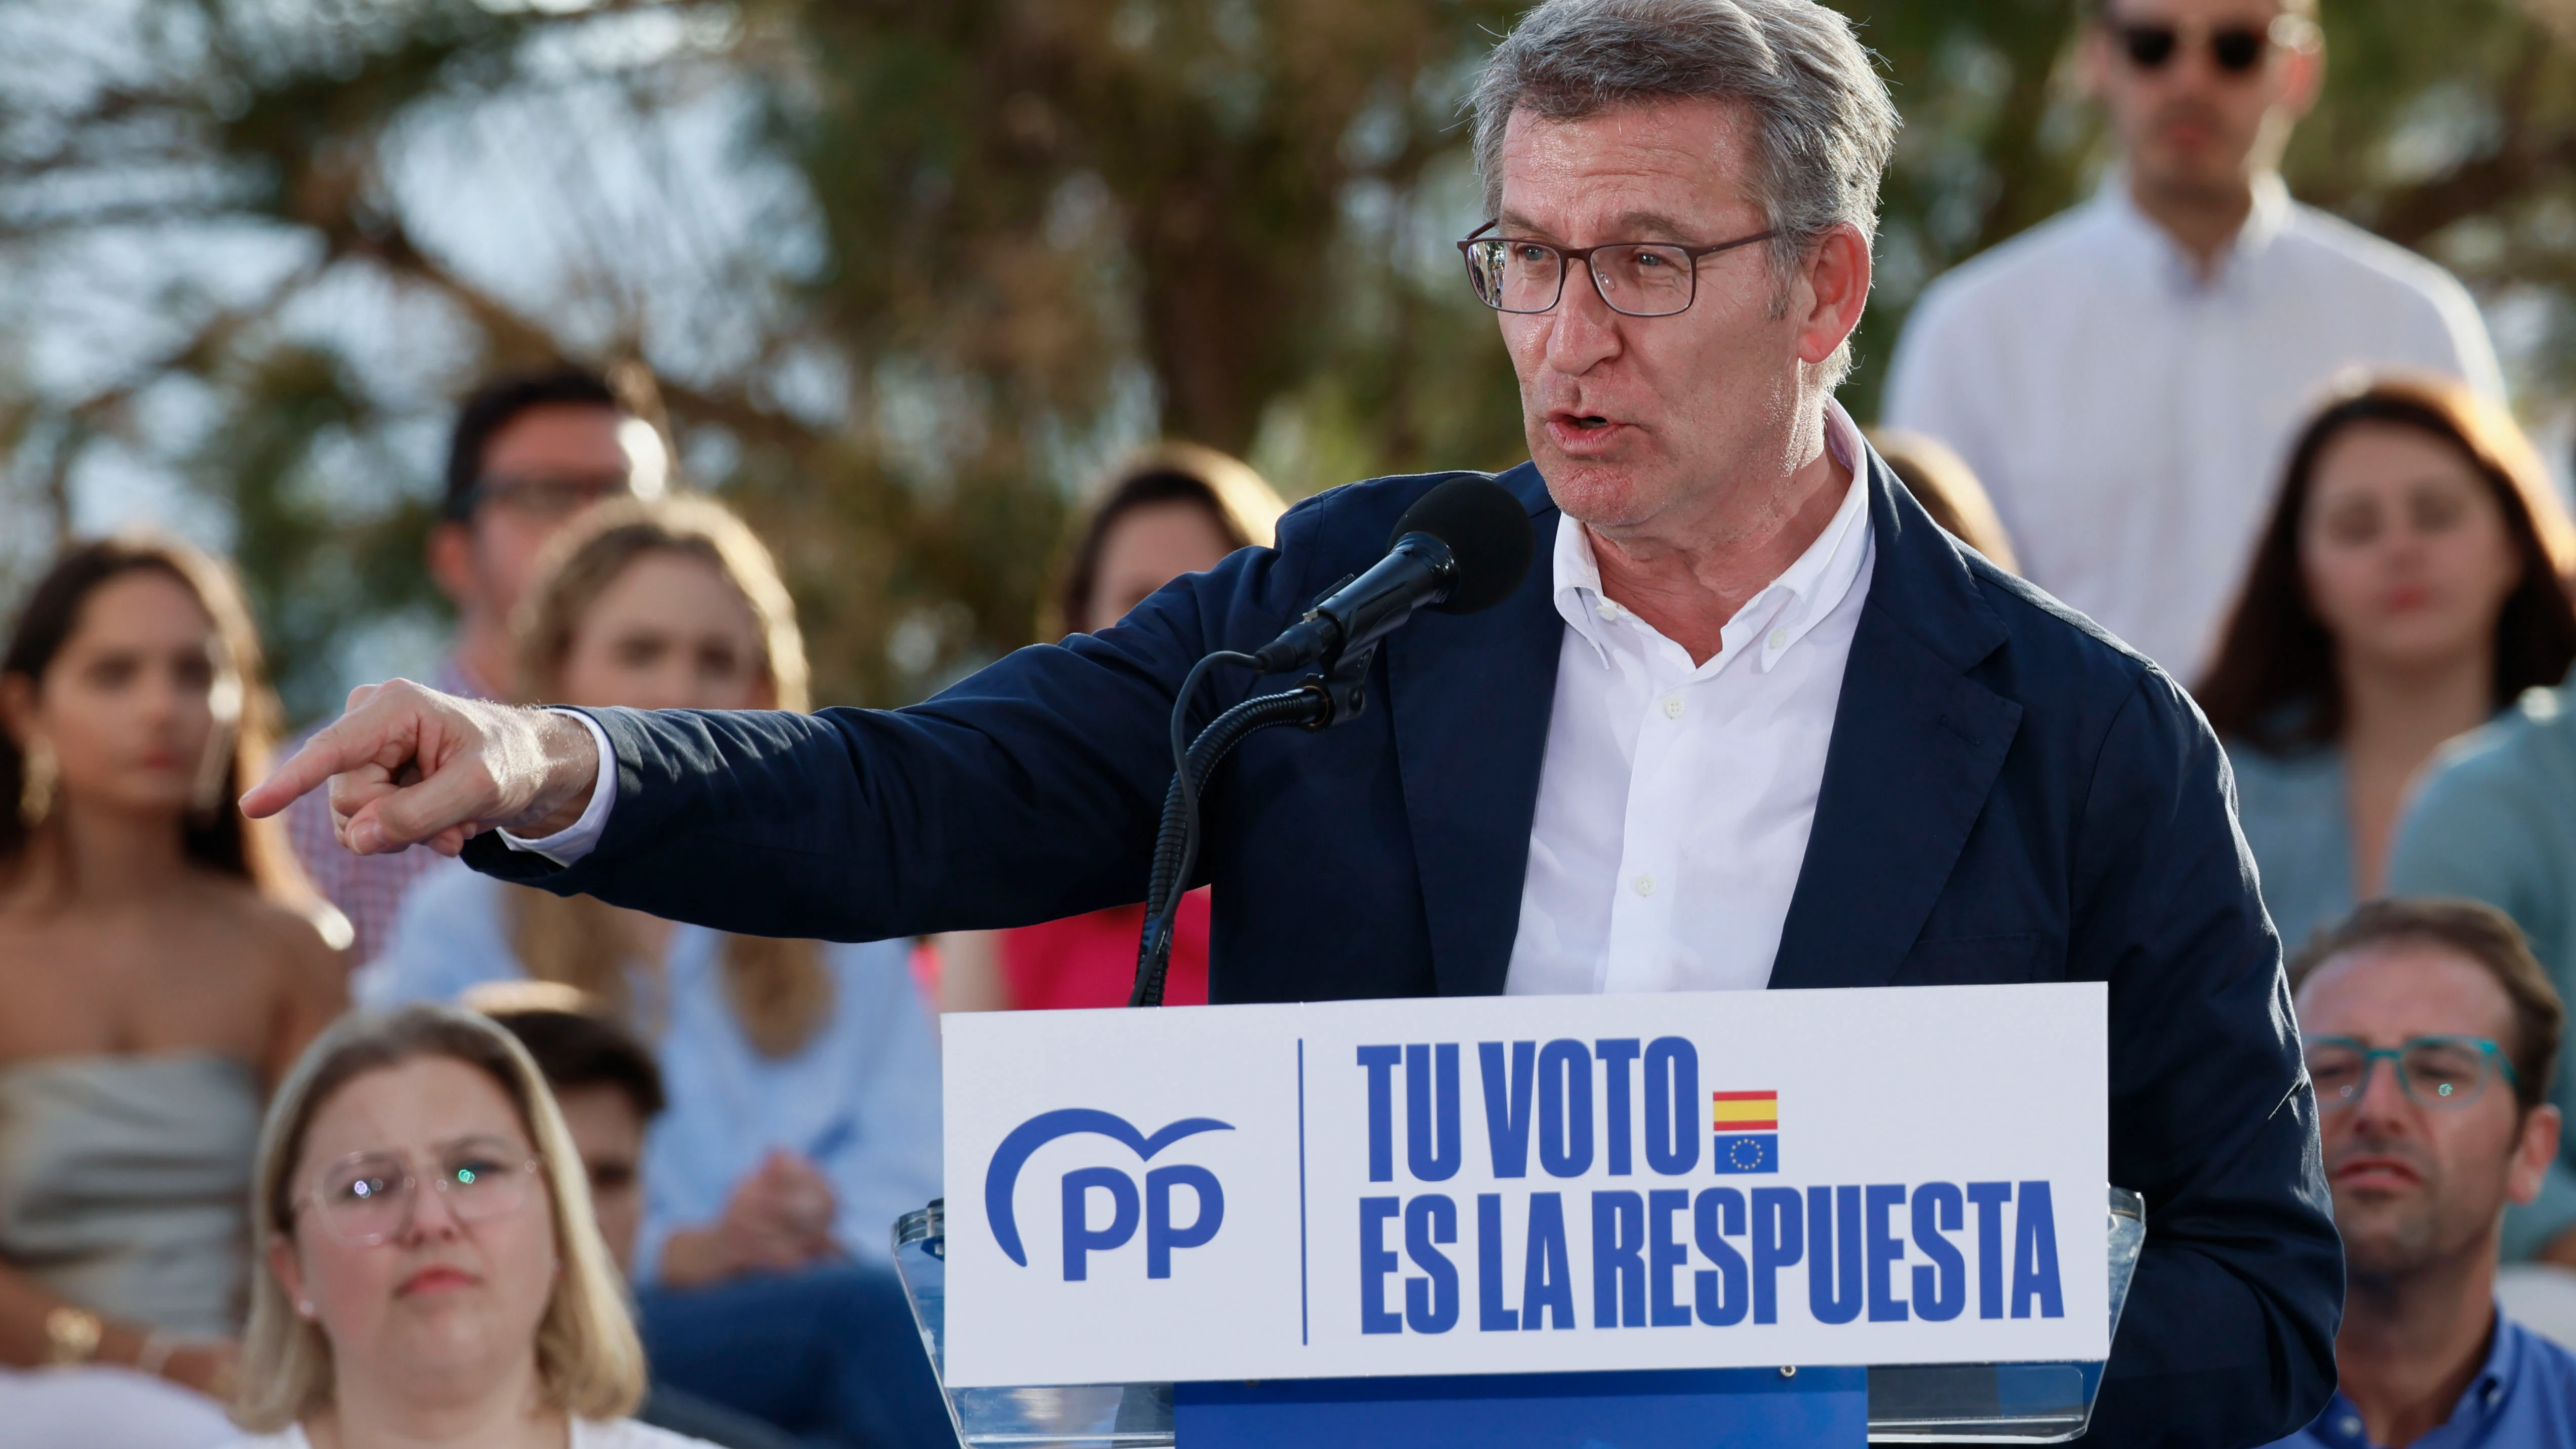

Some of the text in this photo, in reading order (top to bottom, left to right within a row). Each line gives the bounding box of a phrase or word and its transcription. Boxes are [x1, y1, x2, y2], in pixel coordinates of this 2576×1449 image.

[1357, 1036, 1700, 1182] TU VOTO
[1359, 1180, 2065, 1335] ES LA RESPUESTA
